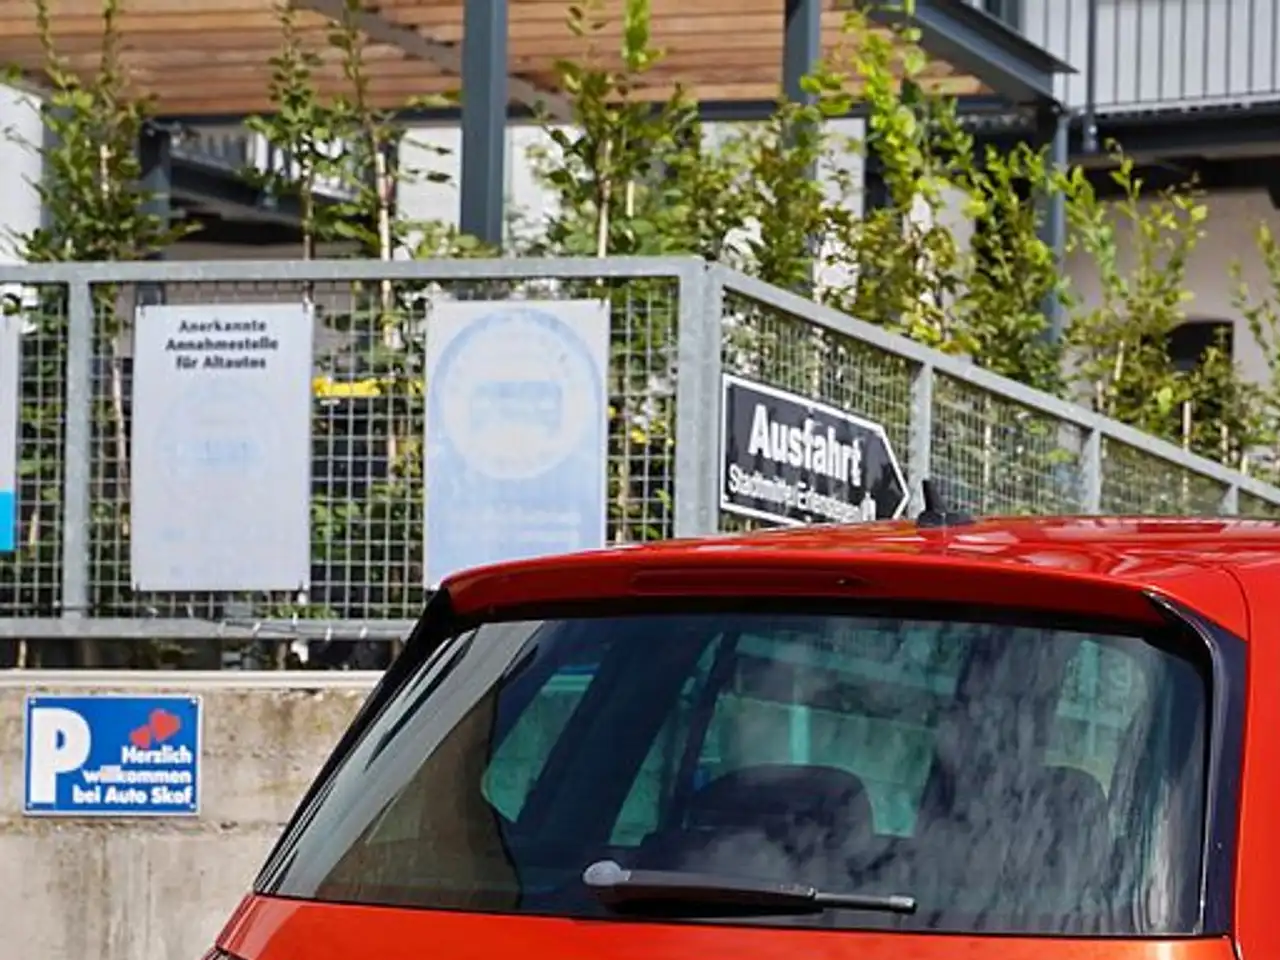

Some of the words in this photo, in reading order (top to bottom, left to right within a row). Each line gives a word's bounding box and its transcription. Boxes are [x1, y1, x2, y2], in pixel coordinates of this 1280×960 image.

[178, 320, 267, 333] Anerkannte
[165, 337, 279, 351] Annahmestelle
[176, 356, 198, 369] für
[203, 356, 267, 370] Altautos
[747, 402, 862, 487] Ausfahrt
[30, 707, 91, 804] P
[121, 745, 192, 764] Herzlich
[82, 765, 191, 783] willkommen
[72, 785, 100, 804] bei
[104, 787, 147, 804] Auto
[151, 786, 193, 804] Skof
